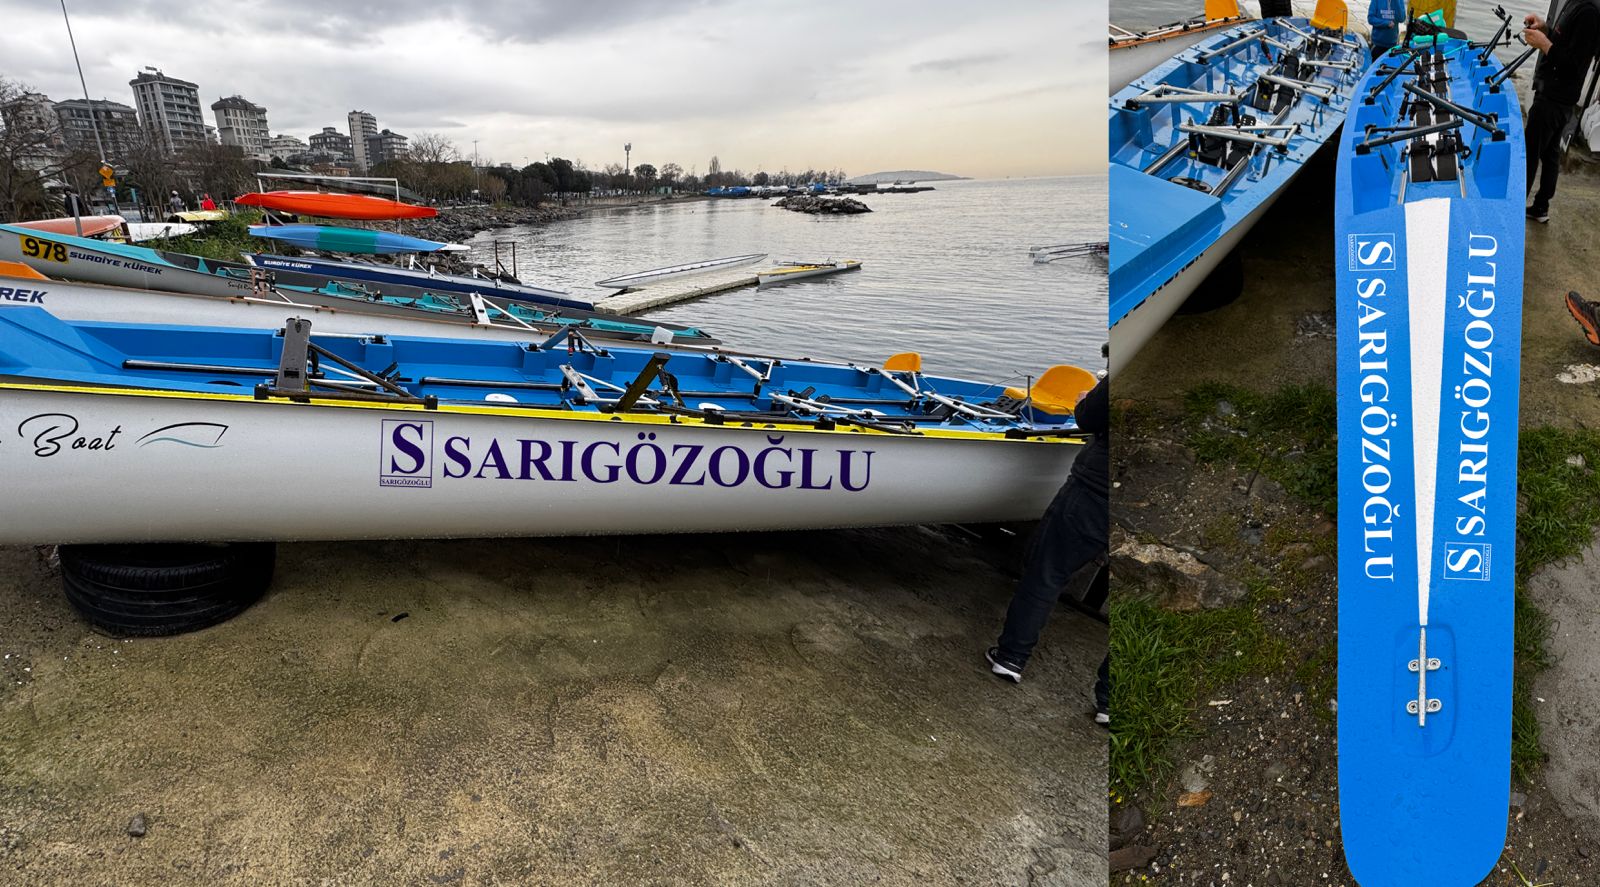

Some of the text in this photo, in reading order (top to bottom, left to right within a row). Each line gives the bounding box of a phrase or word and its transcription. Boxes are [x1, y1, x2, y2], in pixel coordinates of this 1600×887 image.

[123, 261, 164, 275] KÜREK
[1357, 241, 1393, 265] S
[1455, 231, 1498, 536] SARIGÖZOĞLU
[18, 413, 122, 457] Boat
[391, 423, 425, 475] S
[1356, 278, 1400, 582] SARIGÖZOĞLU
[443, 431, 876, 492] SARIGÖZOĞLU
[1446, 548, 1482, 573] S
